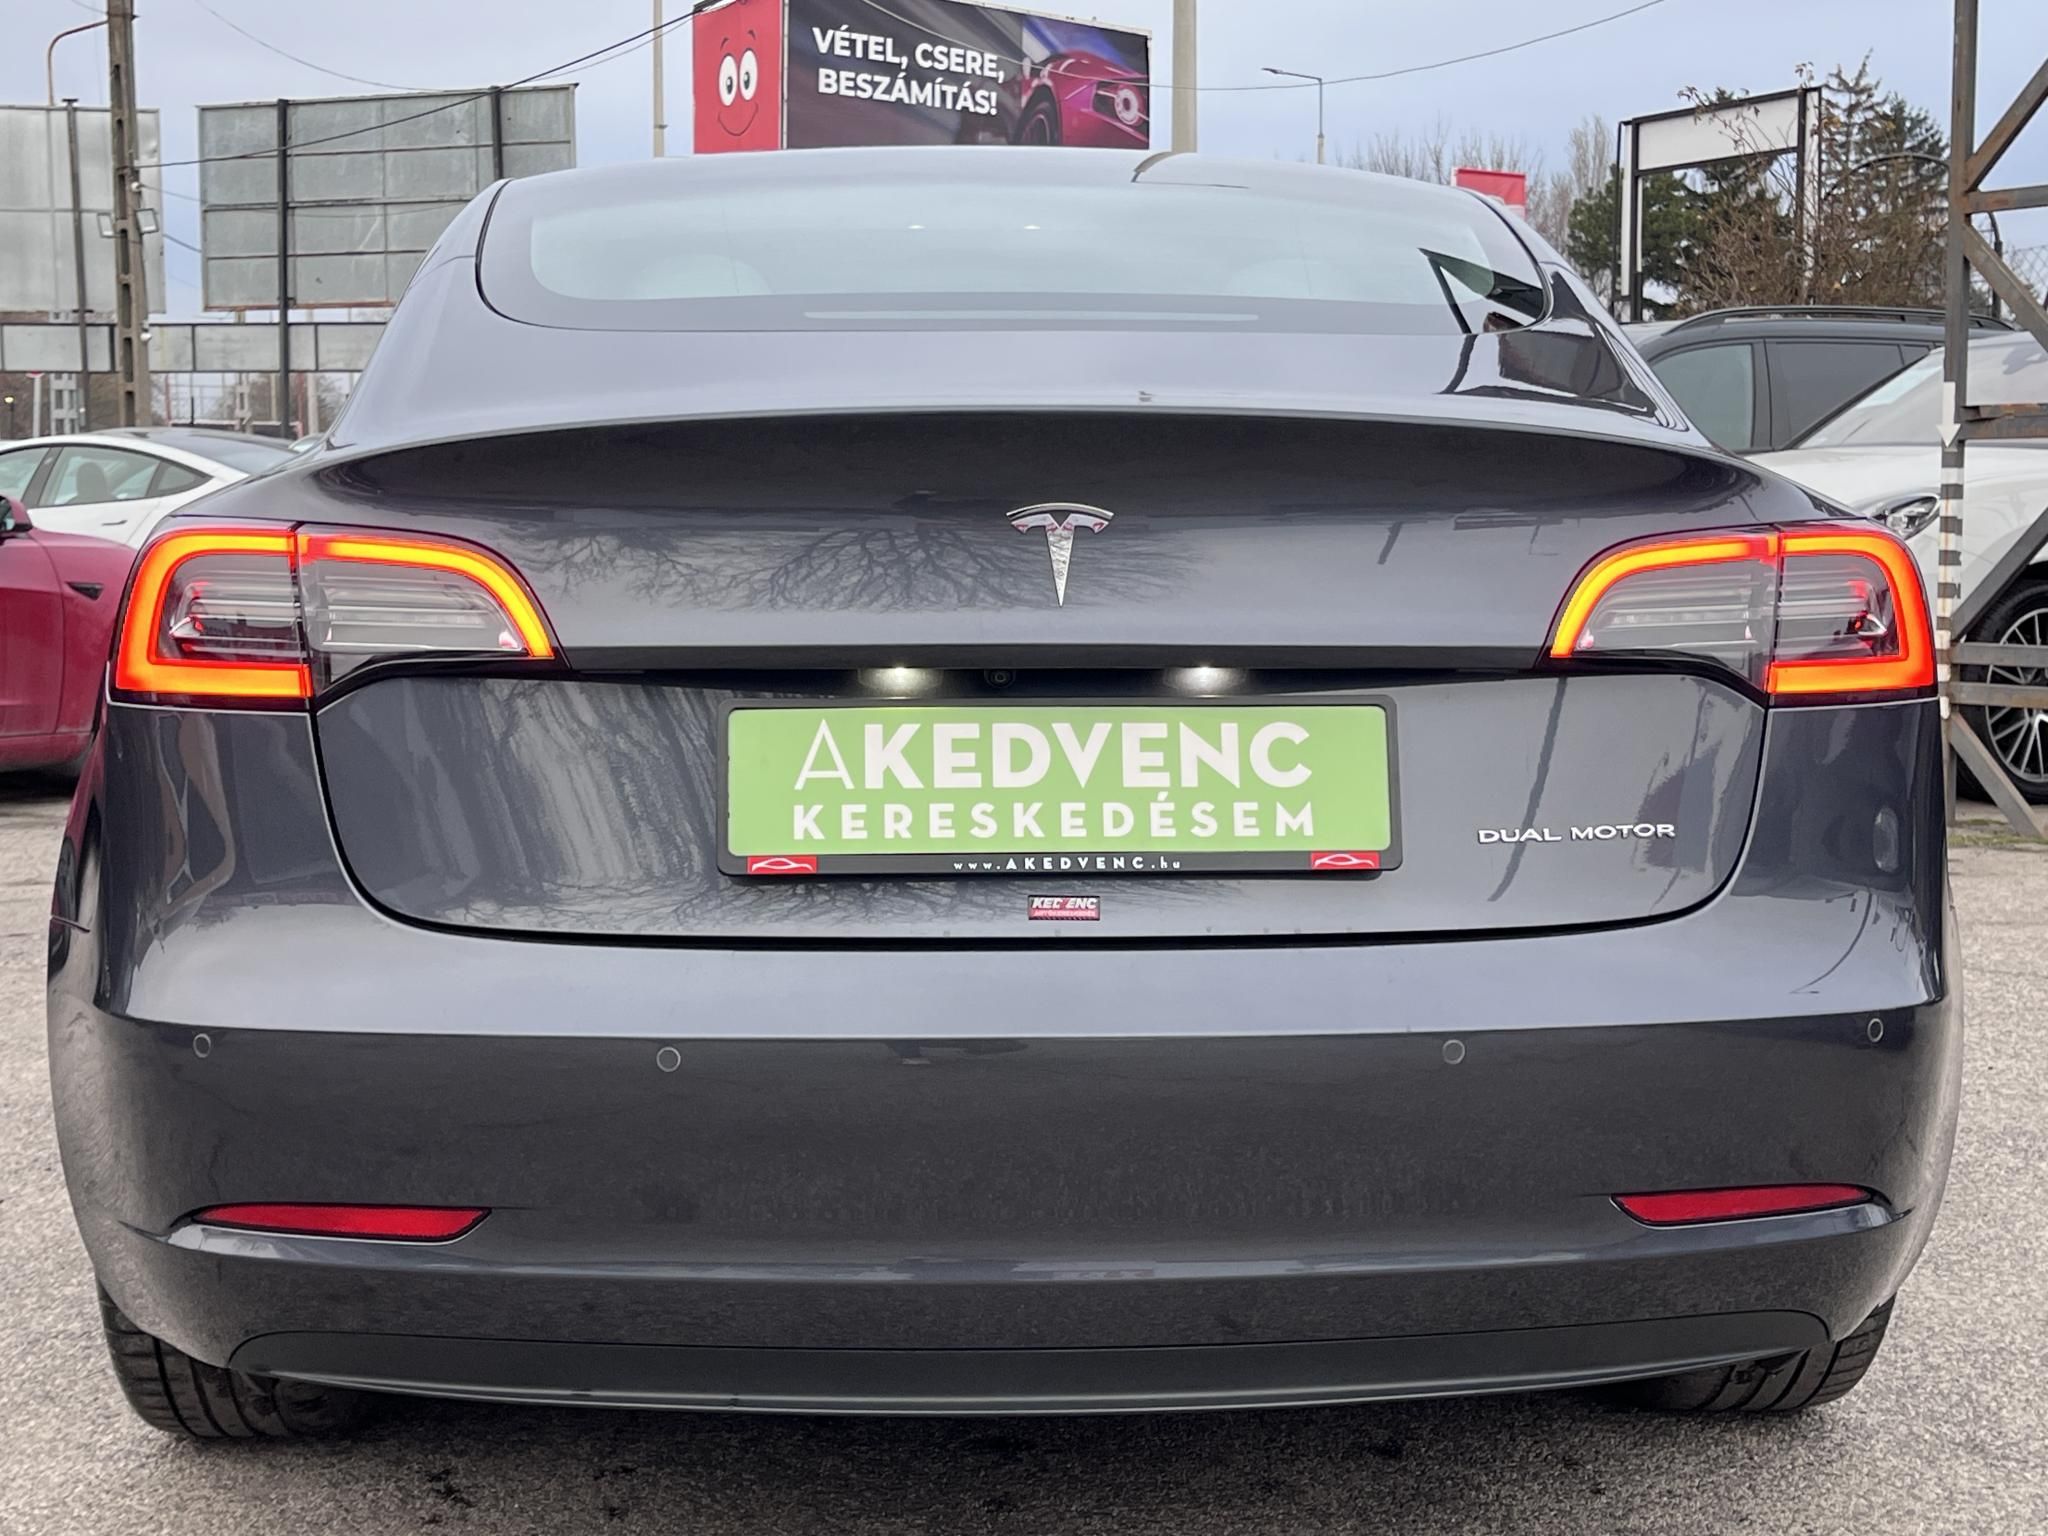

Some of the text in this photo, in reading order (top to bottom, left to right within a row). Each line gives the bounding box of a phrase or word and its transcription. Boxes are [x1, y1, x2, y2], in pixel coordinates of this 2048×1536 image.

[812, 25, 1004, 83] VÉTEL, CSERE,
[818, 68, 998, 115] BESZÁMÍTÁS!
[795, 719, 1312, 790] AKEDVENC
[794, 791, 1314, 841] KERESKEDÉSEM
[1478, 823, 1676, 843] DUAL MOTOR
[953, 856, 1180, 870] www.AKEDVENC.hu
